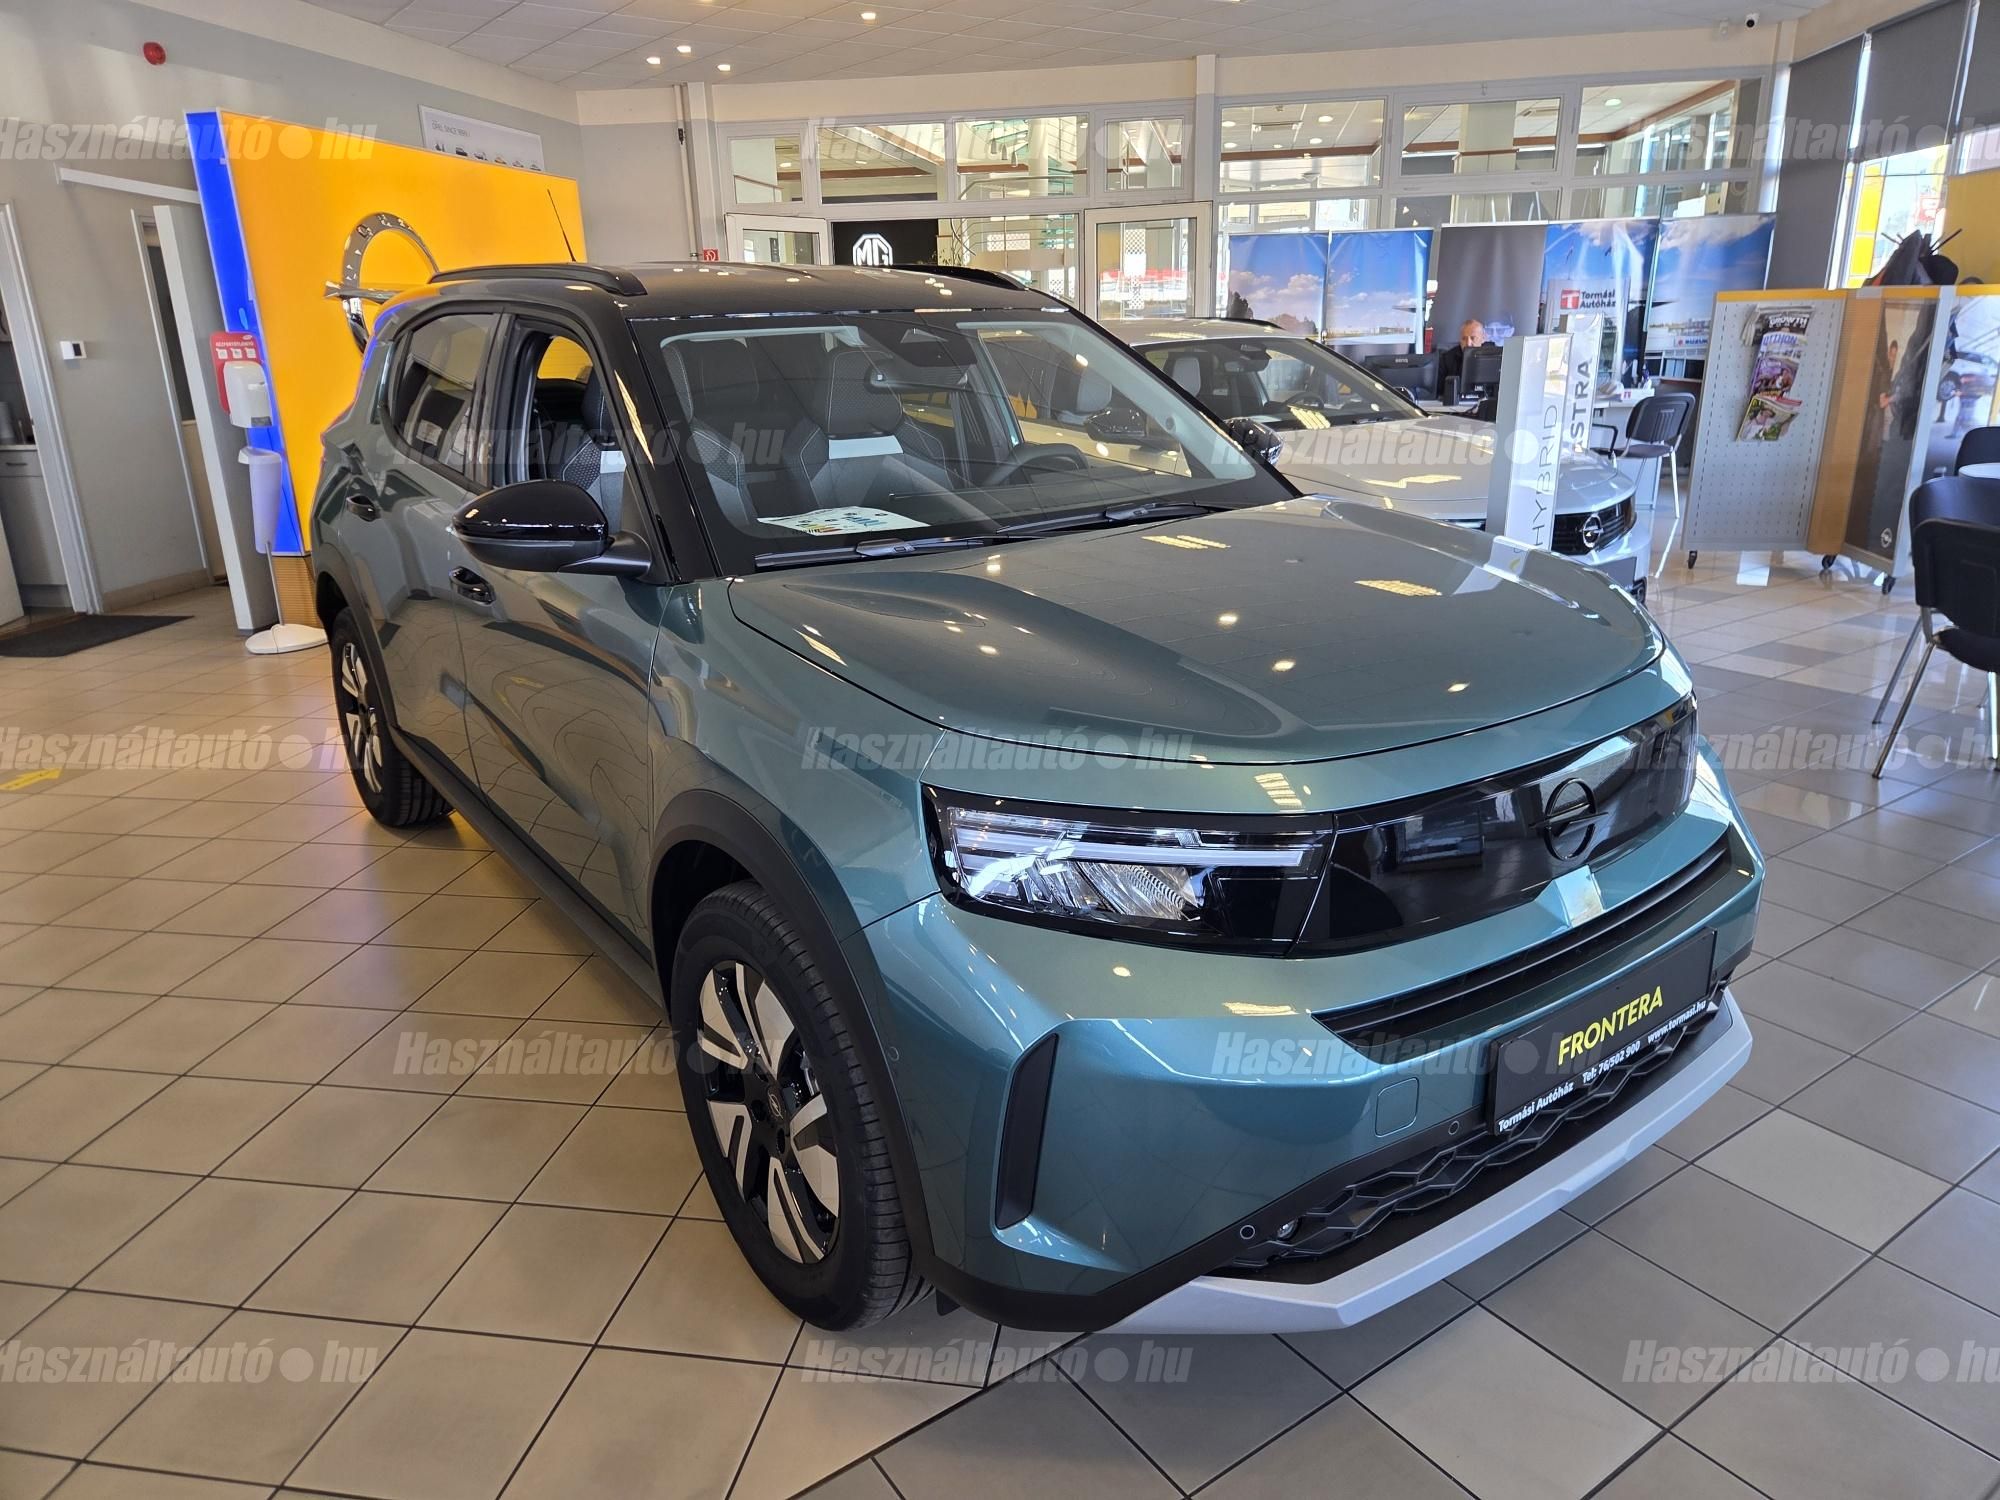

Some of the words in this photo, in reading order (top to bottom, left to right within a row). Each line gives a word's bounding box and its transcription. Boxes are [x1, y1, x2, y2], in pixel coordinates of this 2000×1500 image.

[855, 235, 891, 266] MG
[1580, 300, 1616, 309] Autóház
[1532, 405, 1558, 547] HYBRID
[1558, 985, 1663, 1066] FRONTERA
[1498, 1101, 1535, 1132] Tormási
[1536, 1082, 1574, 1111] Autóház
[1582, 1067, 1597, 1083] Tel:
[1599, 1052, 1625, 1074] 76/502
[1625, 1040, 1640, 1058] 900
